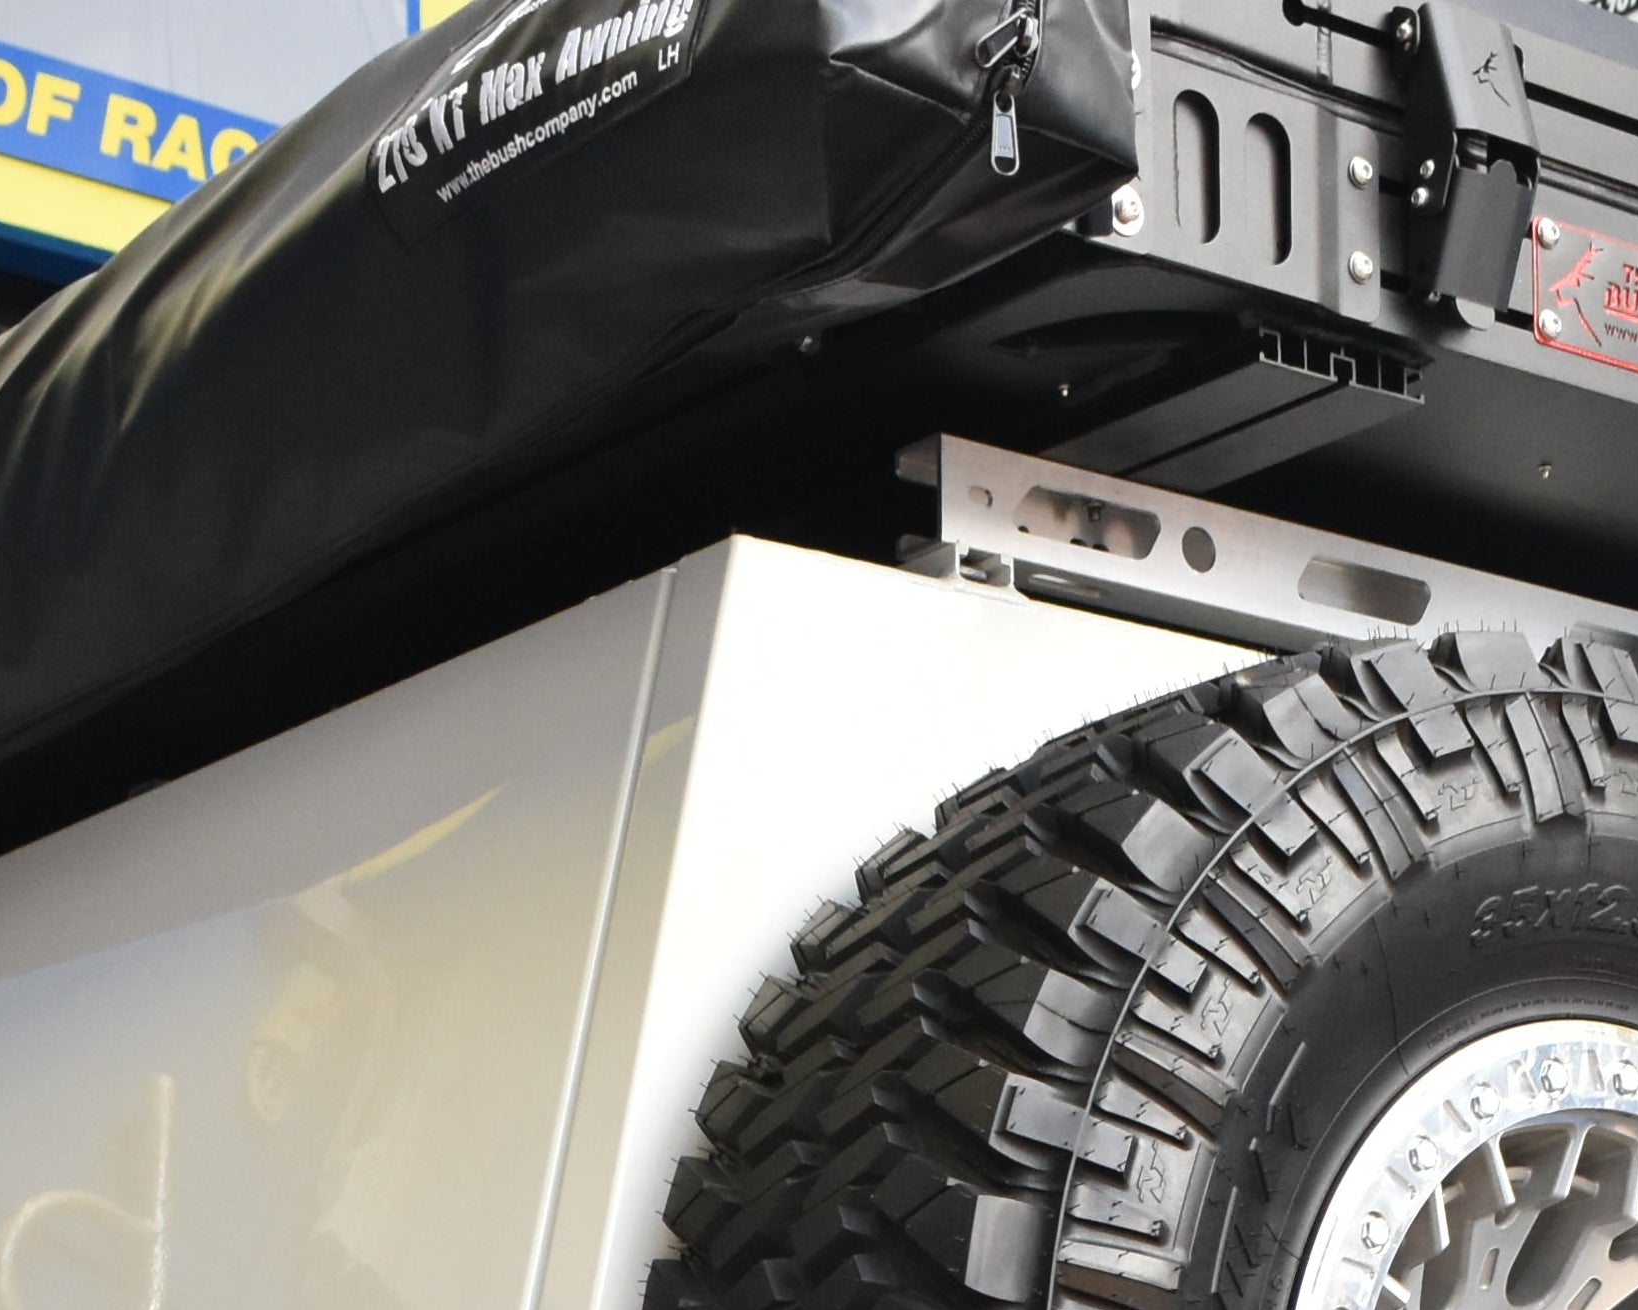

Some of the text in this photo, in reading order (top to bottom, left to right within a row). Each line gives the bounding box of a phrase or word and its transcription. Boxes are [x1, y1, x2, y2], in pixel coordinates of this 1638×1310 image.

[479, 52, 546, 126] Max
[658, 42, 680, 72] LH
[101, 90, 257, 182] RAC
[436, 70, 638, 203] www.thebushcompany.com
